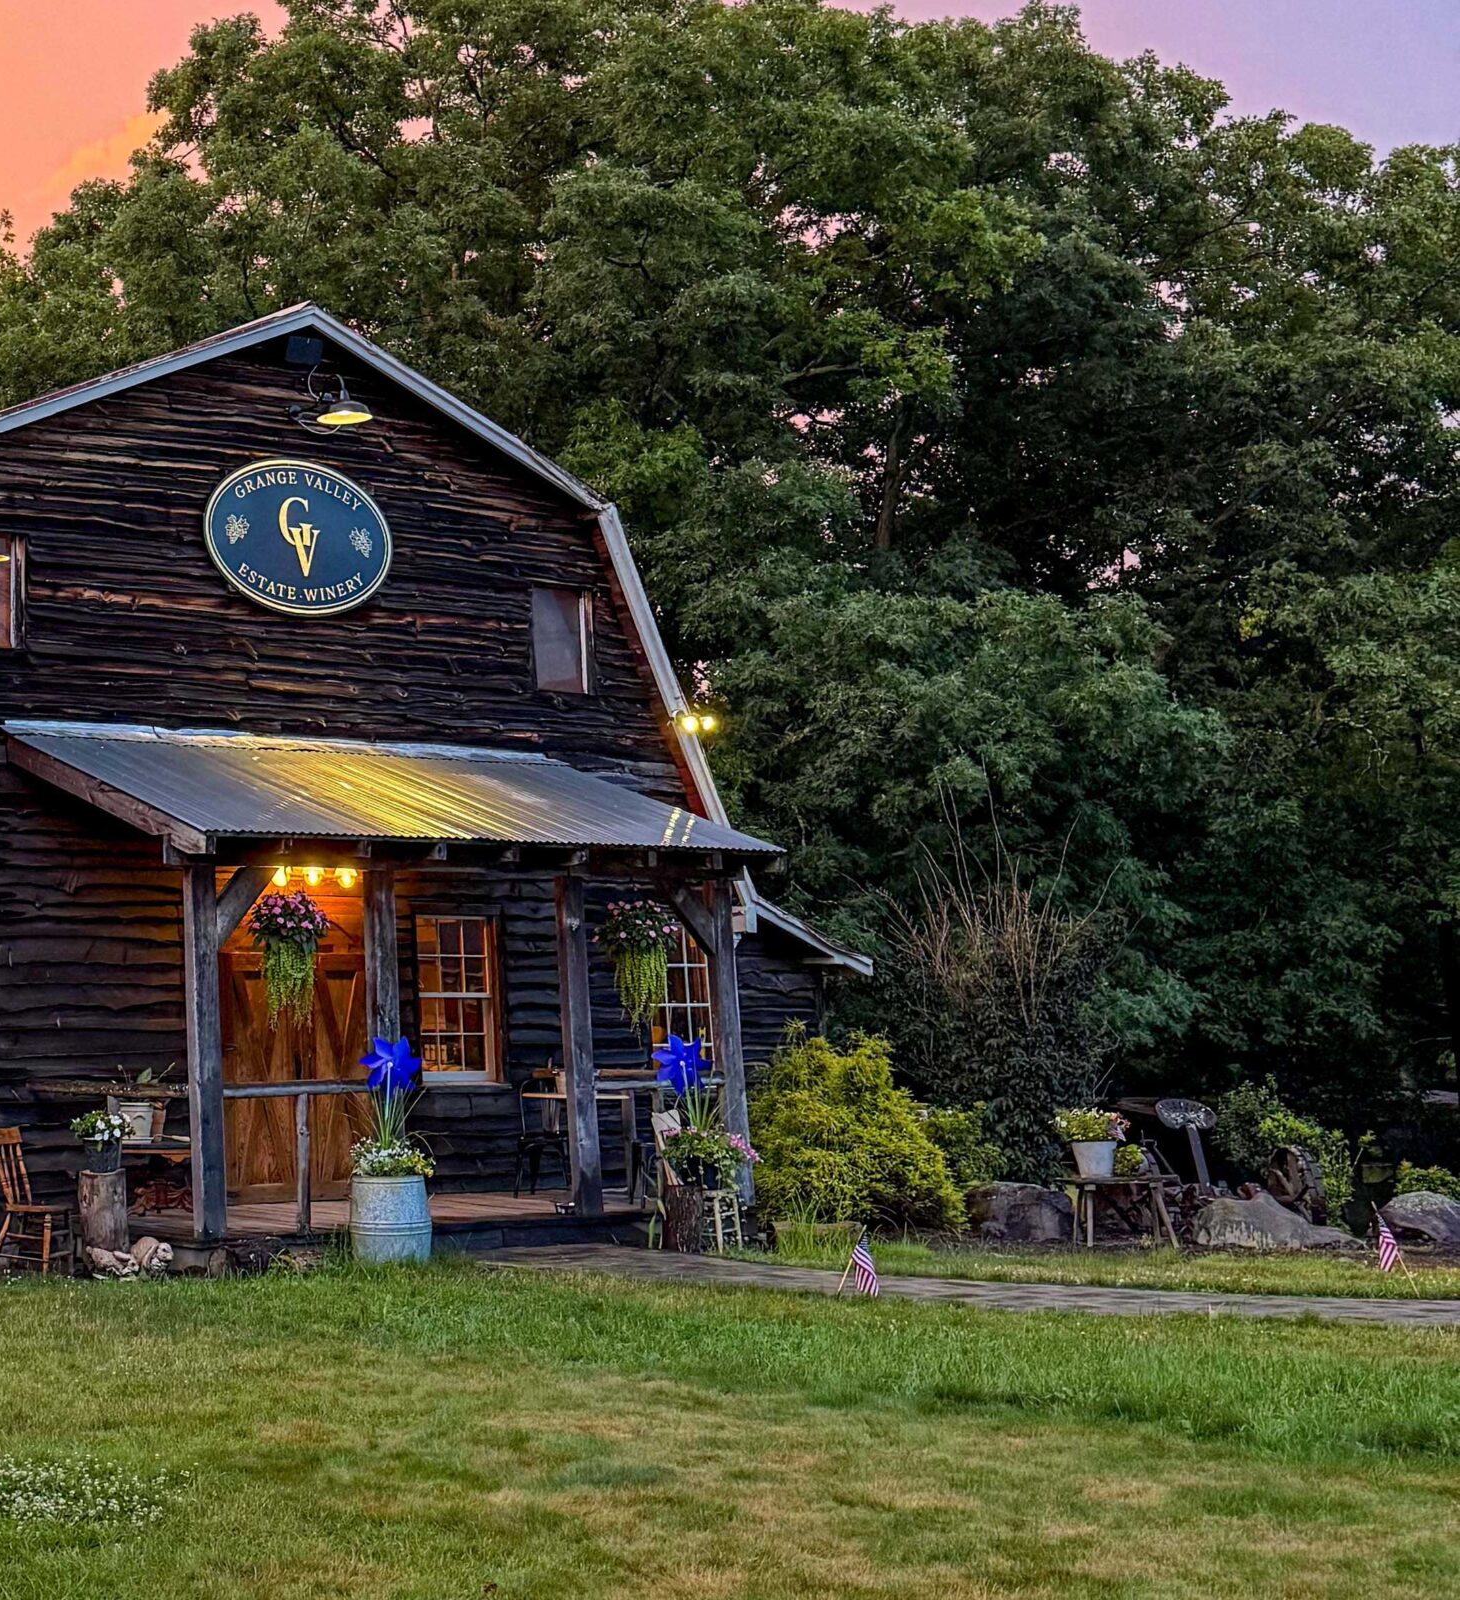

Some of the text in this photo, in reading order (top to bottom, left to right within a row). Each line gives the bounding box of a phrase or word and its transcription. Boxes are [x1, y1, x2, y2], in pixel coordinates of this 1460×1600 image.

[235, 471, 362, 512] GRANGE VALLEY
[278, 496, 321, 577] GV
[238, 562, 364, 602] ESTATE WINERY
